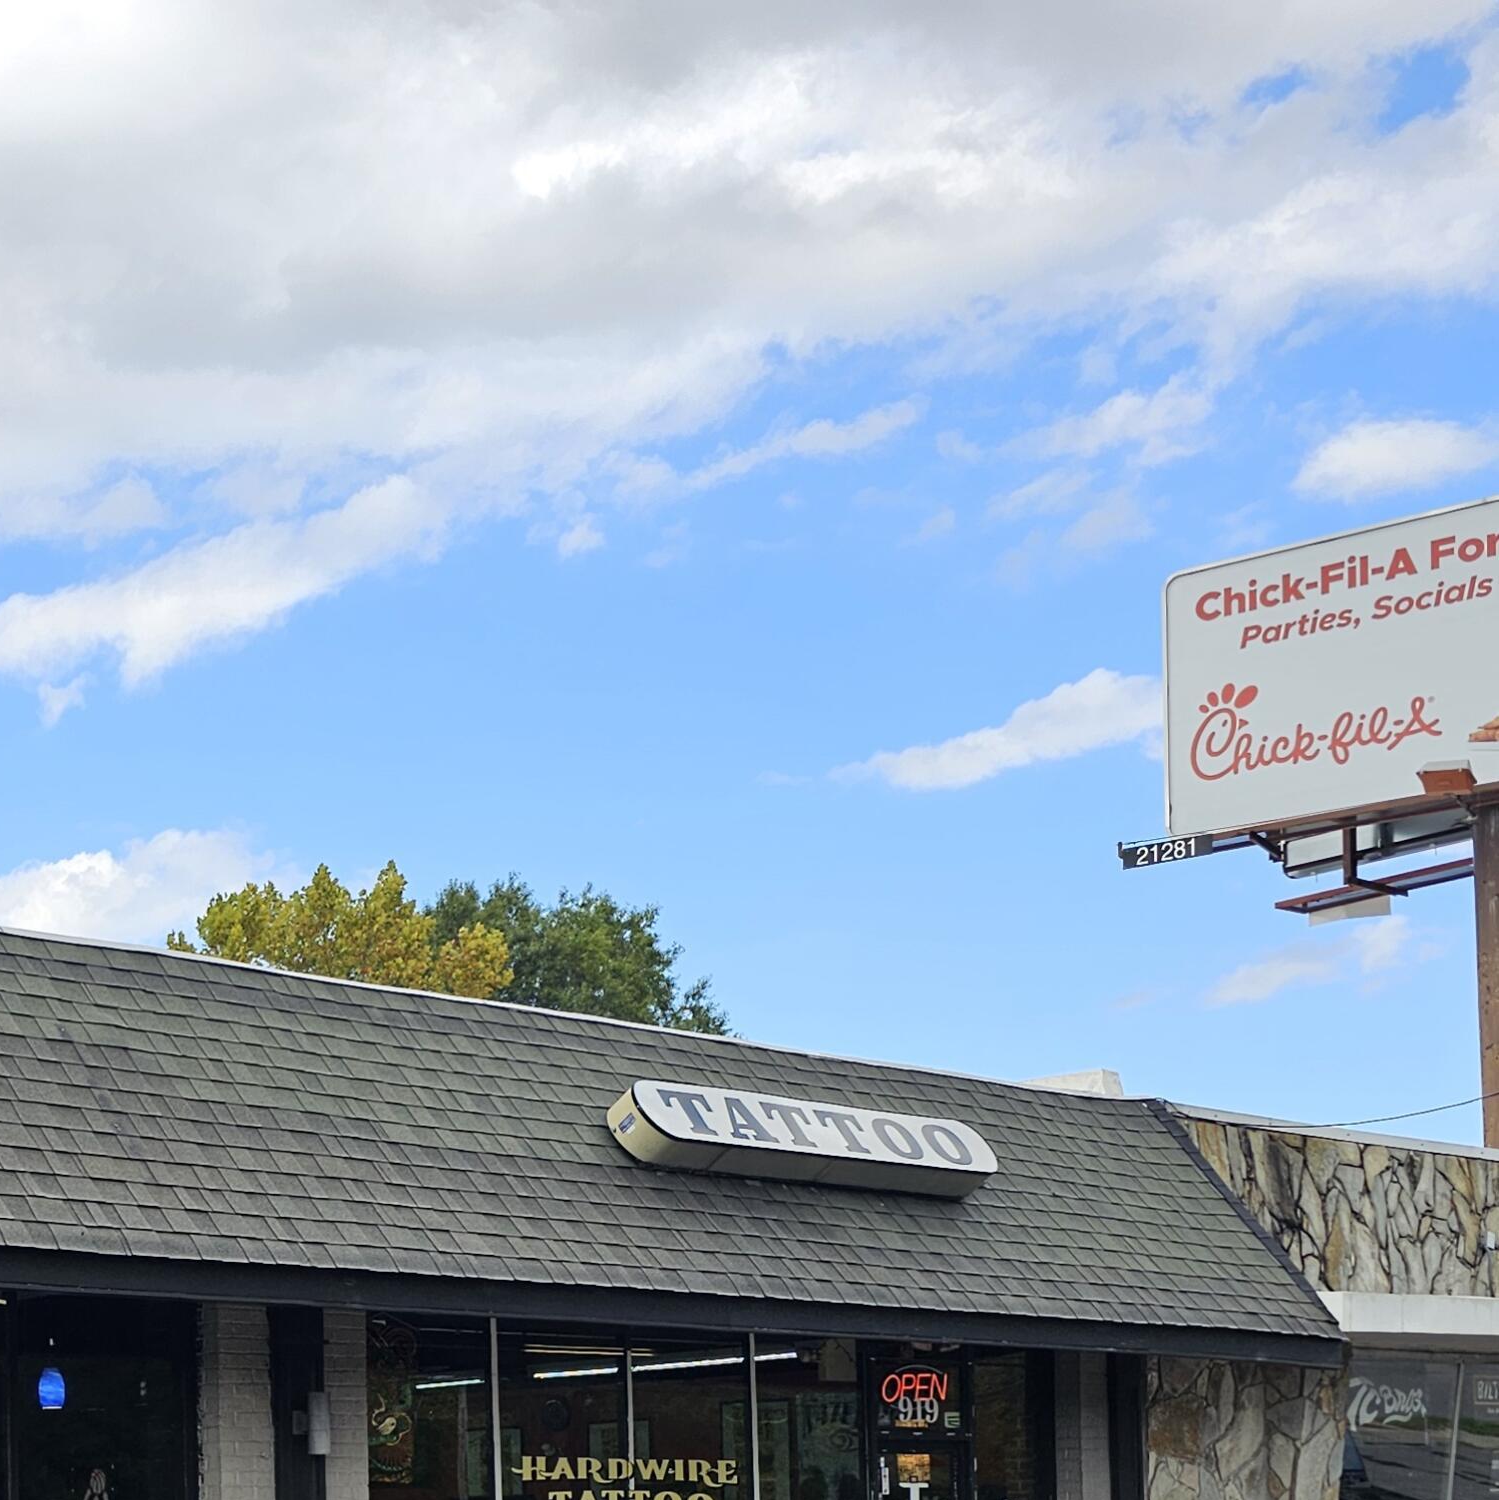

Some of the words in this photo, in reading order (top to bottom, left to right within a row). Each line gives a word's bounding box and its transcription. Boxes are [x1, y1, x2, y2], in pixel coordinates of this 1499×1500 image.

[1195, 547, 1418, 621] Chick-Fil-A
[1240, 608, 1361, 649] Parties,
[1371, 575, 1493, 619] Socials
[1136, 837, 1195, 866] 21281
[656, 1088, 974, 1166] TATTOO
[881, 1373, 948, 1403] OPEN
[898, 1396, 940, 1423] 919
[511, 1455, 738, 1488] HARDWIRE
